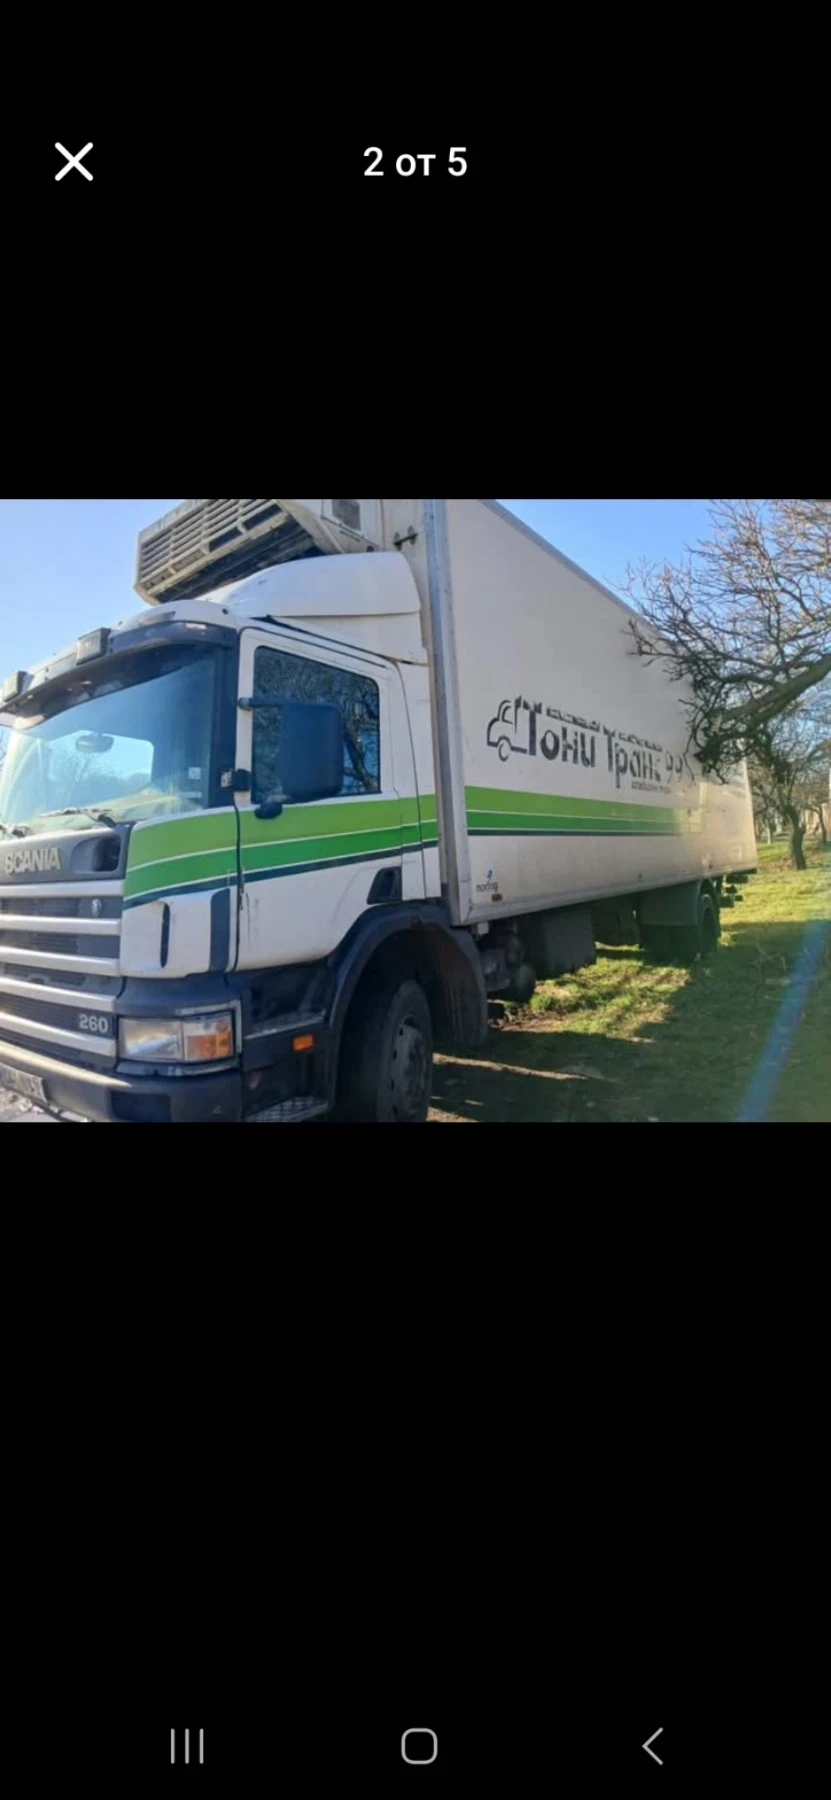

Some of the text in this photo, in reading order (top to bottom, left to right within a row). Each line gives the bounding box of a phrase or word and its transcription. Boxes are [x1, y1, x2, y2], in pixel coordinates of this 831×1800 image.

[515, 698, 597, 768] Тони
[4, 847, 61, 874] SCANIA
[79, 1013, 109, 1034] 260
